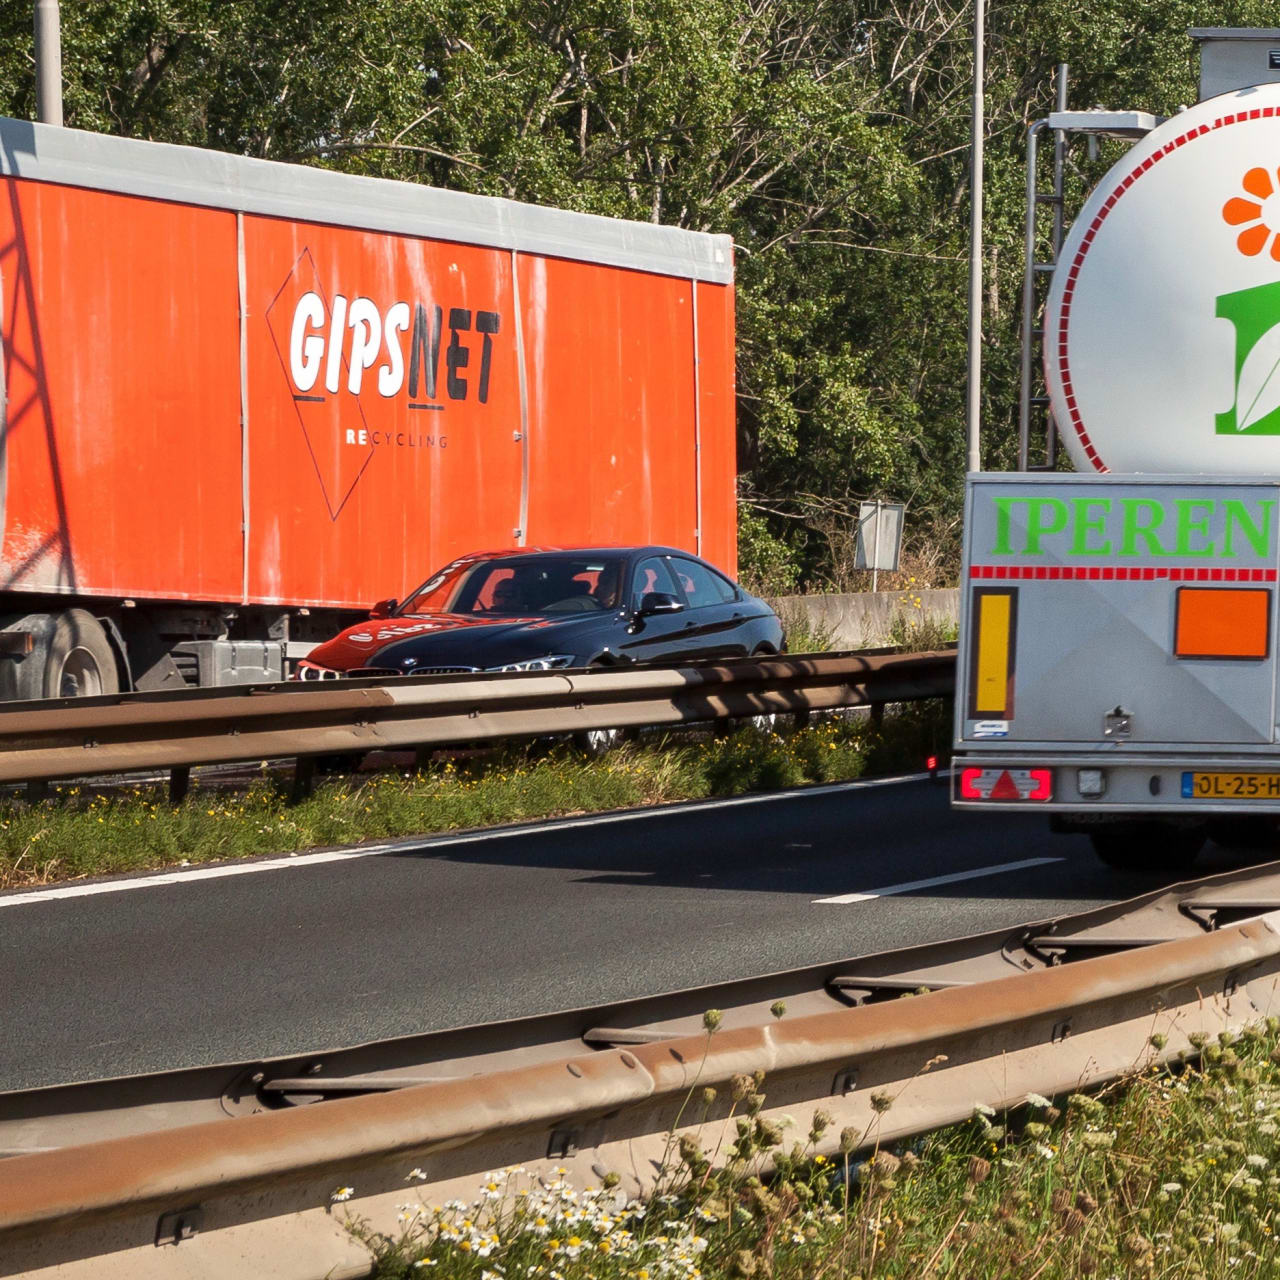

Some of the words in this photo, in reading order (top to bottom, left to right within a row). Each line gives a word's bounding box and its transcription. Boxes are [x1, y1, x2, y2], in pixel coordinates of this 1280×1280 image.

[289, 290, 501, 405] GIPSNET
[345, 428, 449, 449] RECYCLING
[991, 496, 1277, 558] IPEREN
